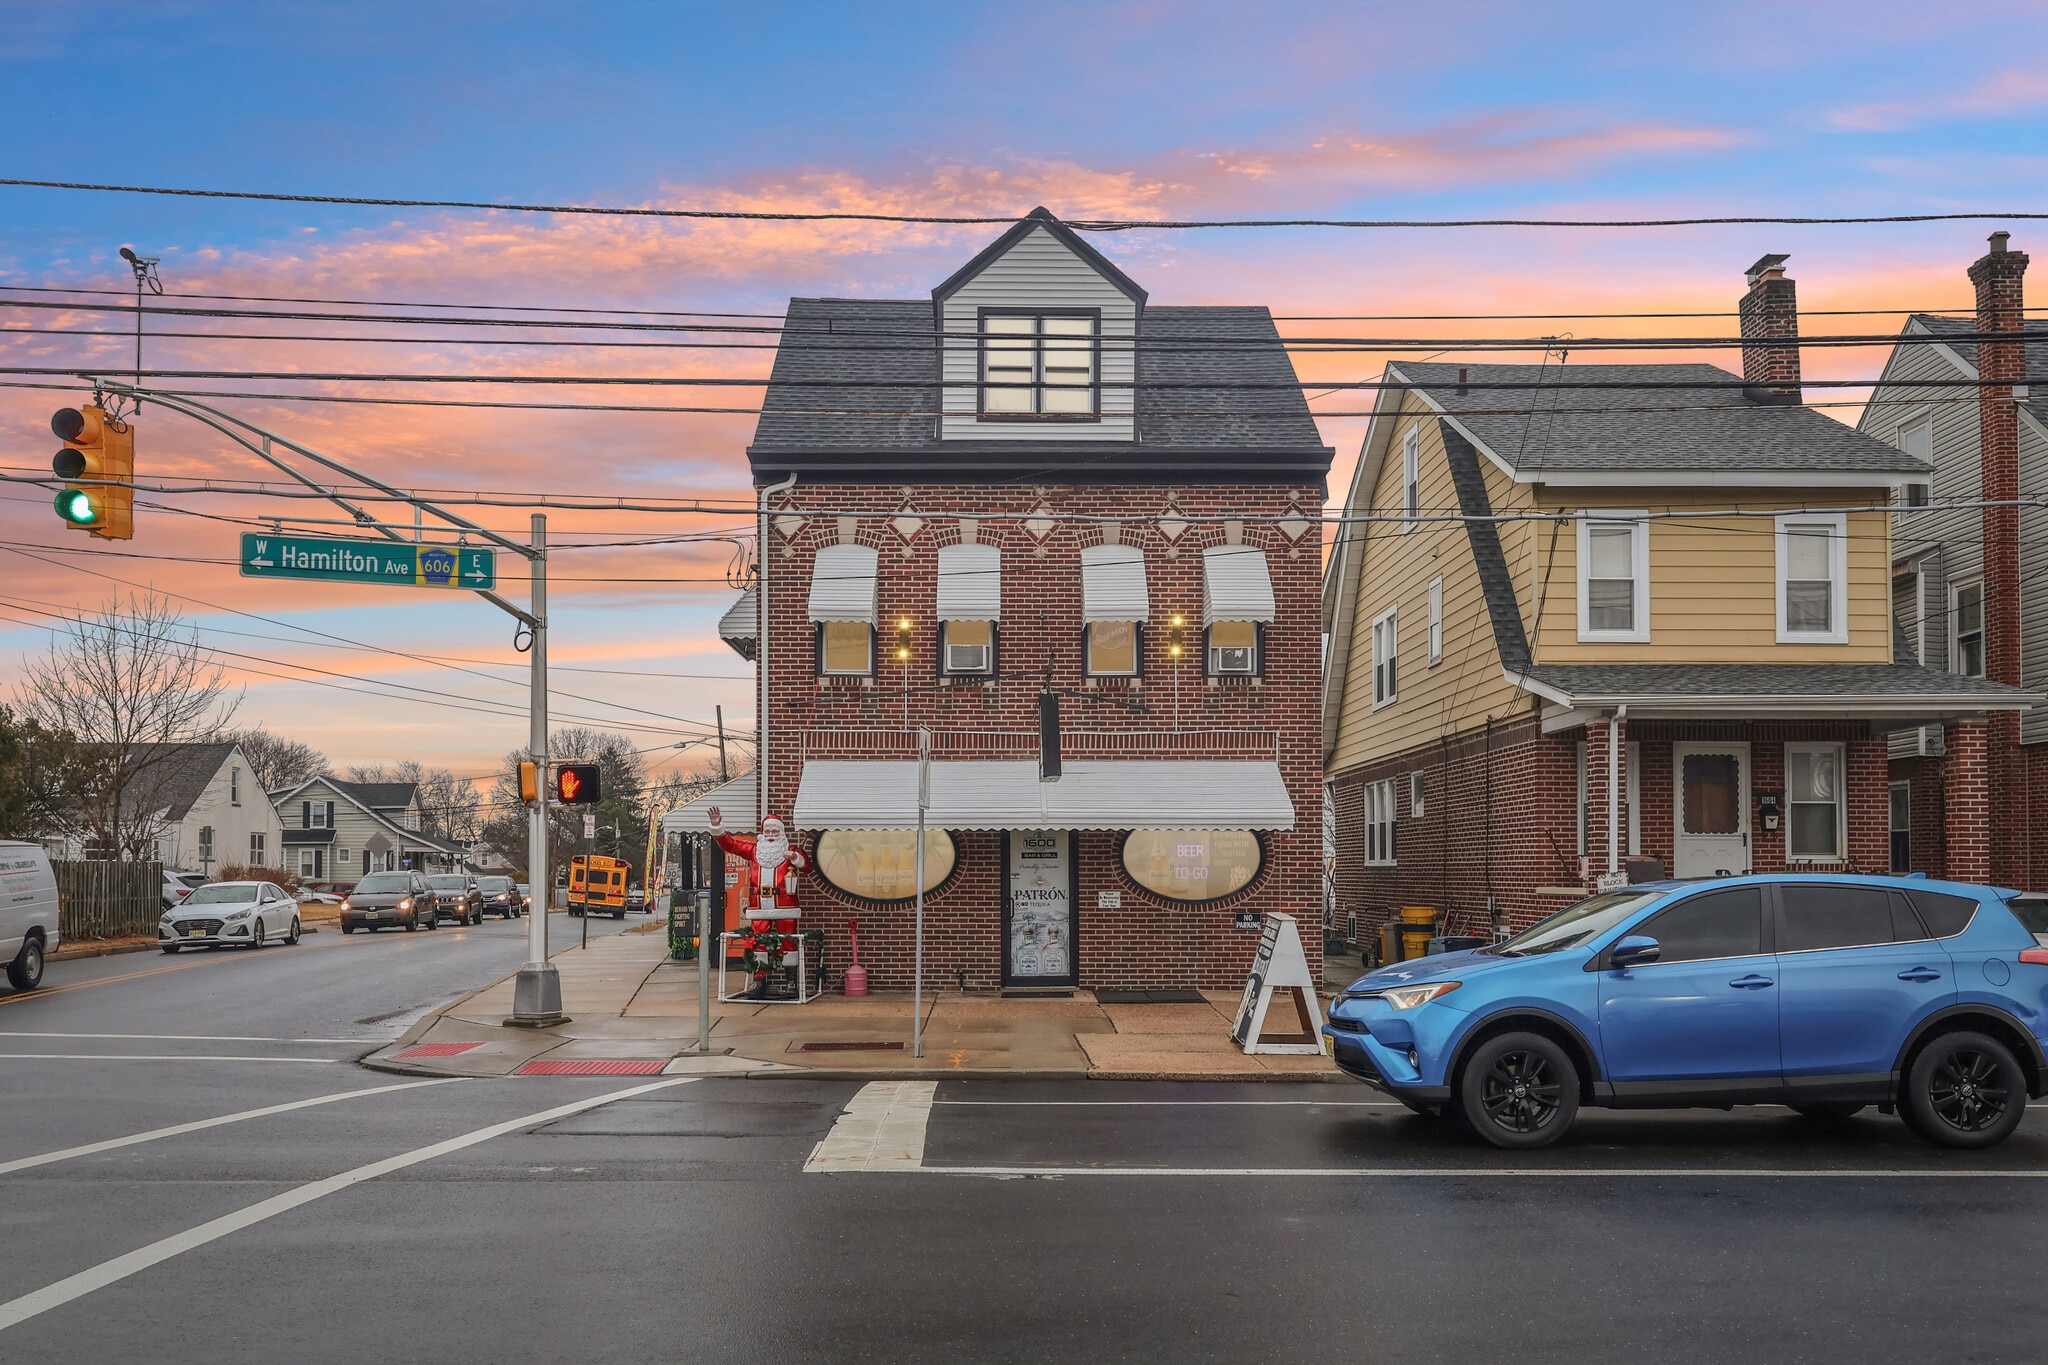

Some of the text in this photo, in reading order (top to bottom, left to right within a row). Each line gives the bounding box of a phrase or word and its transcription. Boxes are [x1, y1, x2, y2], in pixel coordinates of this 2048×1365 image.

[256, 540, 267, 554] W
[282, 545, 408, 575] Hamilton Ave
[424, 559, 450, 573] 606
[473, 554, 481, 567] E
[1024, 839, 1055, 847] 1600
[1233, 840, 1249, 848] WITH
[1177, 845, 1204, 857] BEER
[1174, 867, 1208, 880] TO-GO
[674, 920, 686, 928] SPIRIT
